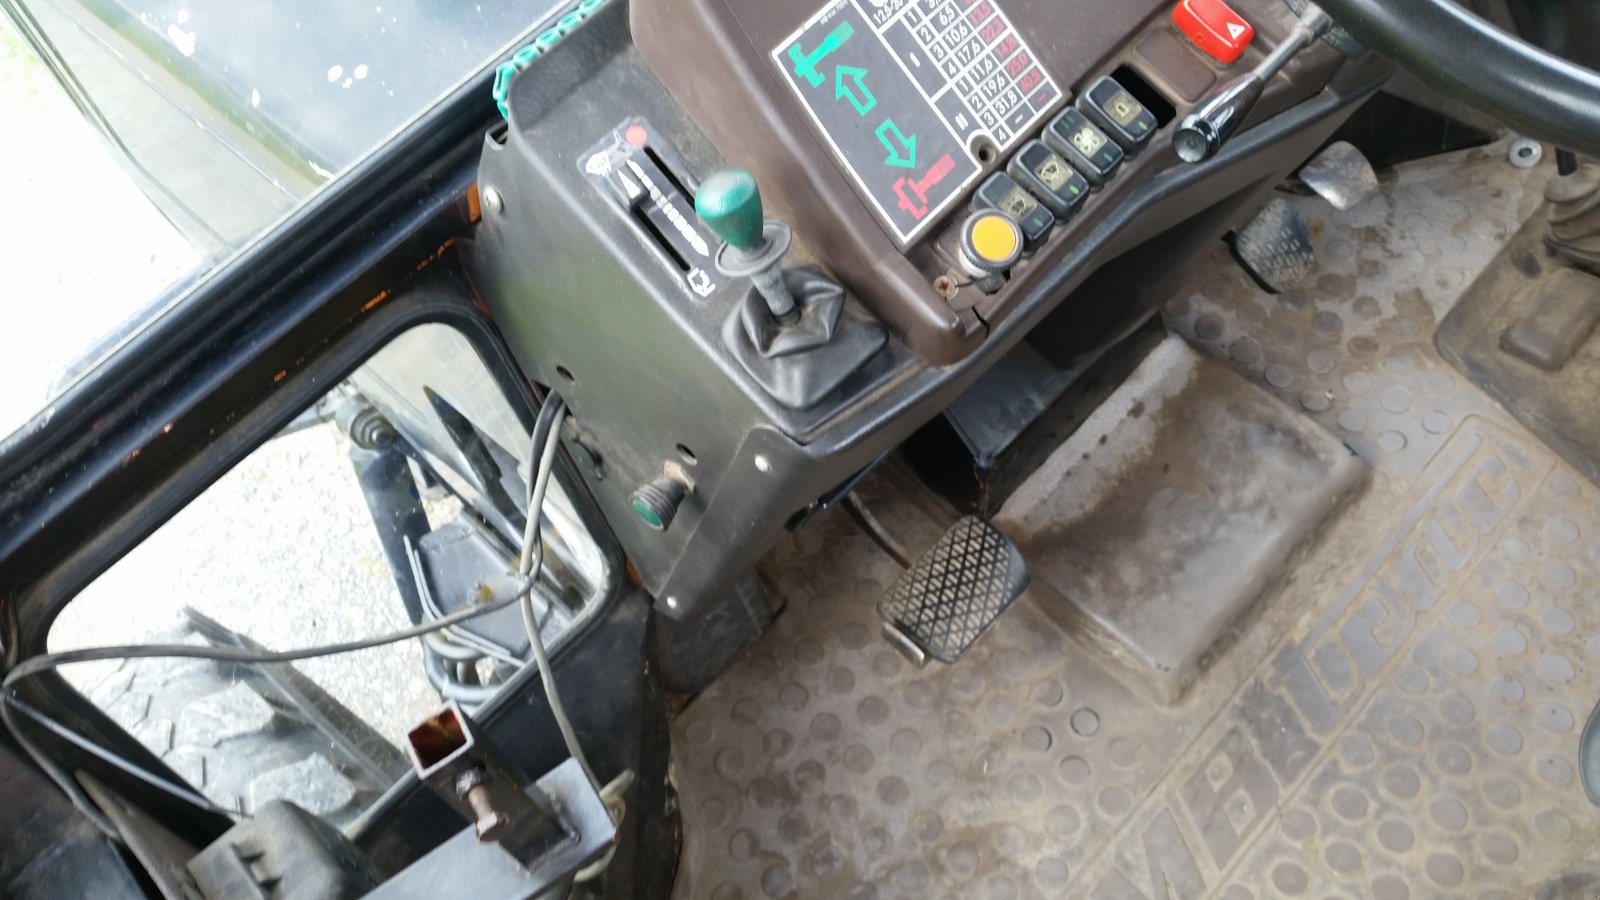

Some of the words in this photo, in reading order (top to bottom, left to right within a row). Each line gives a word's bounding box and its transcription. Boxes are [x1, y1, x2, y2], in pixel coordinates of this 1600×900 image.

[920, 27, 932, 42] 2
[940, 3, 955, 26] 6,5
[934, 44, 944, 59] 3
[945, 22, 968, 46] 10,6
[948, 60, 957, 75] 4
[958, 39, 980, 63] 17,6
[971, 57, 992, 80] 11,6
[972, 95, 982, 109] 2
[983, 73, 1005, 97] 19,6
[984, 112, 994, 125] 3
[996, 90, 1017, 115] 31,8
[998, 128, 1007, 141] 4
